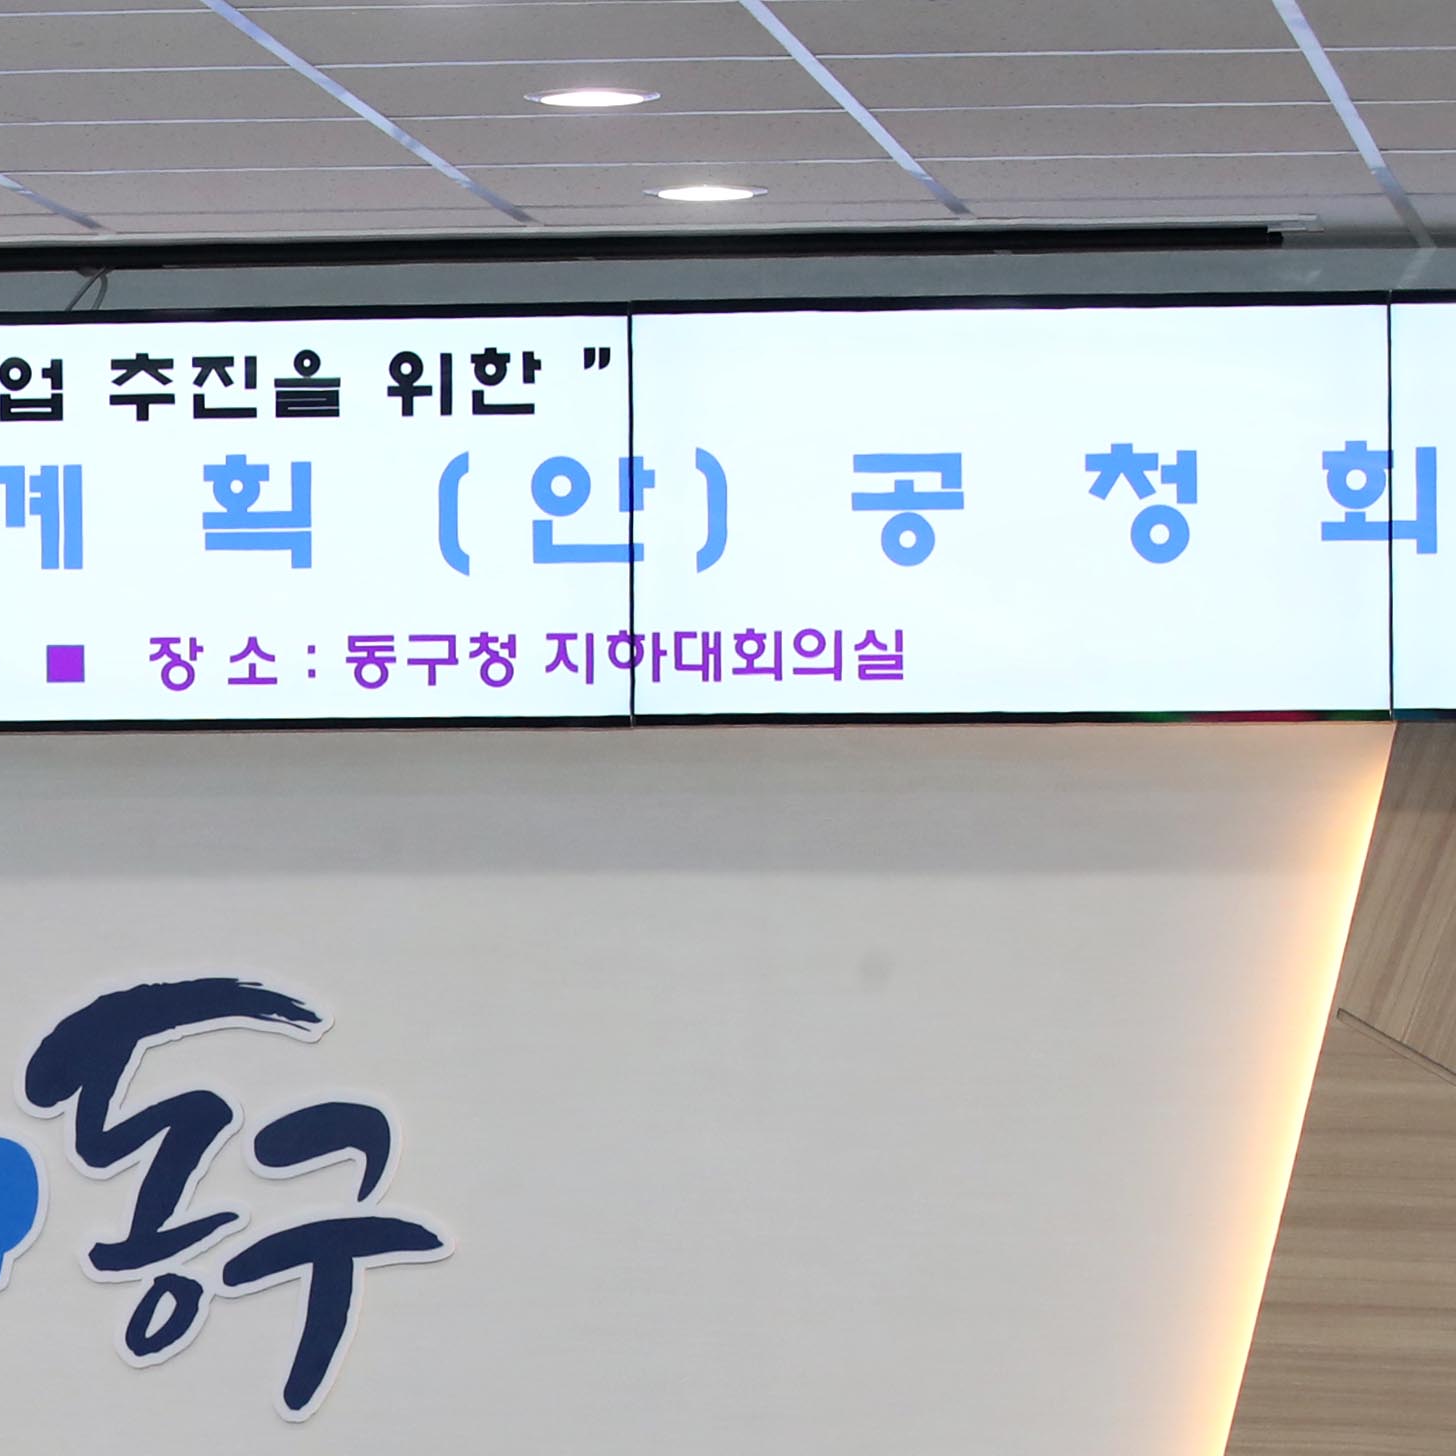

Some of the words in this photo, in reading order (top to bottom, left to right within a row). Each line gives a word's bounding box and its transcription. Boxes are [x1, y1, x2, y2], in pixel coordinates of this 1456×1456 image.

[109, 349, 341, 421] 추진을
[387, 347, 541, 417] 위한
[346, 632, 516, 689] 동구청
[546, 627, 904, 684] 지하대회의실
[26, 977, 446, 1412] 동구
